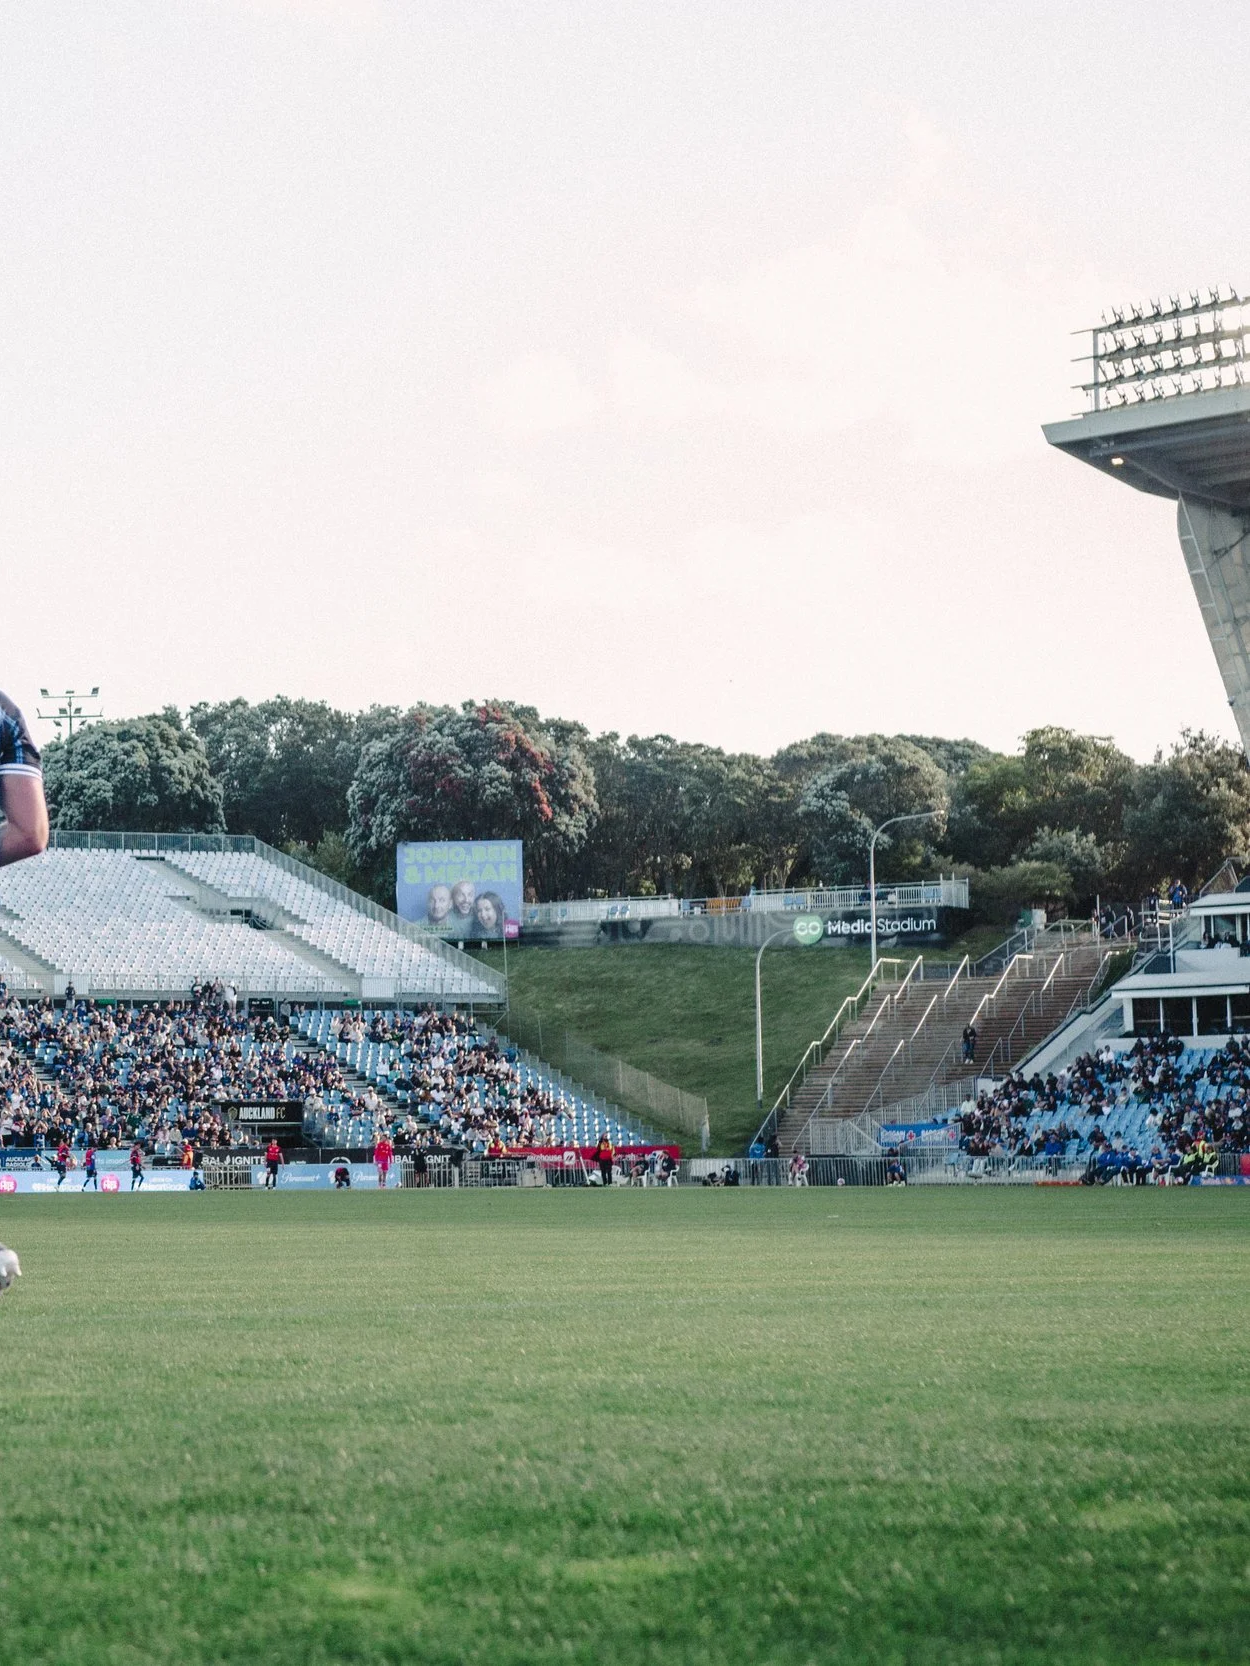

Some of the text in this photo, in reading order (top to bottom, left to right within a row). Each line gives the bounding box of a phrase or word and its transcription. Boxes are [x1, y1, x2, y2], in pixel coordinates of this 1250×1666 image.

[424, 863, 517, 883] MEGAN
[795, 916, 937, 936] GO Media Stadium
[239, 1107, 286, 1120] AUCKLAND FC
[232, 1155, 267, 1165] IGNITE
[425, 1155, 452, 1164] GNIT
[526, 1153, 563, 1162] arehouse
